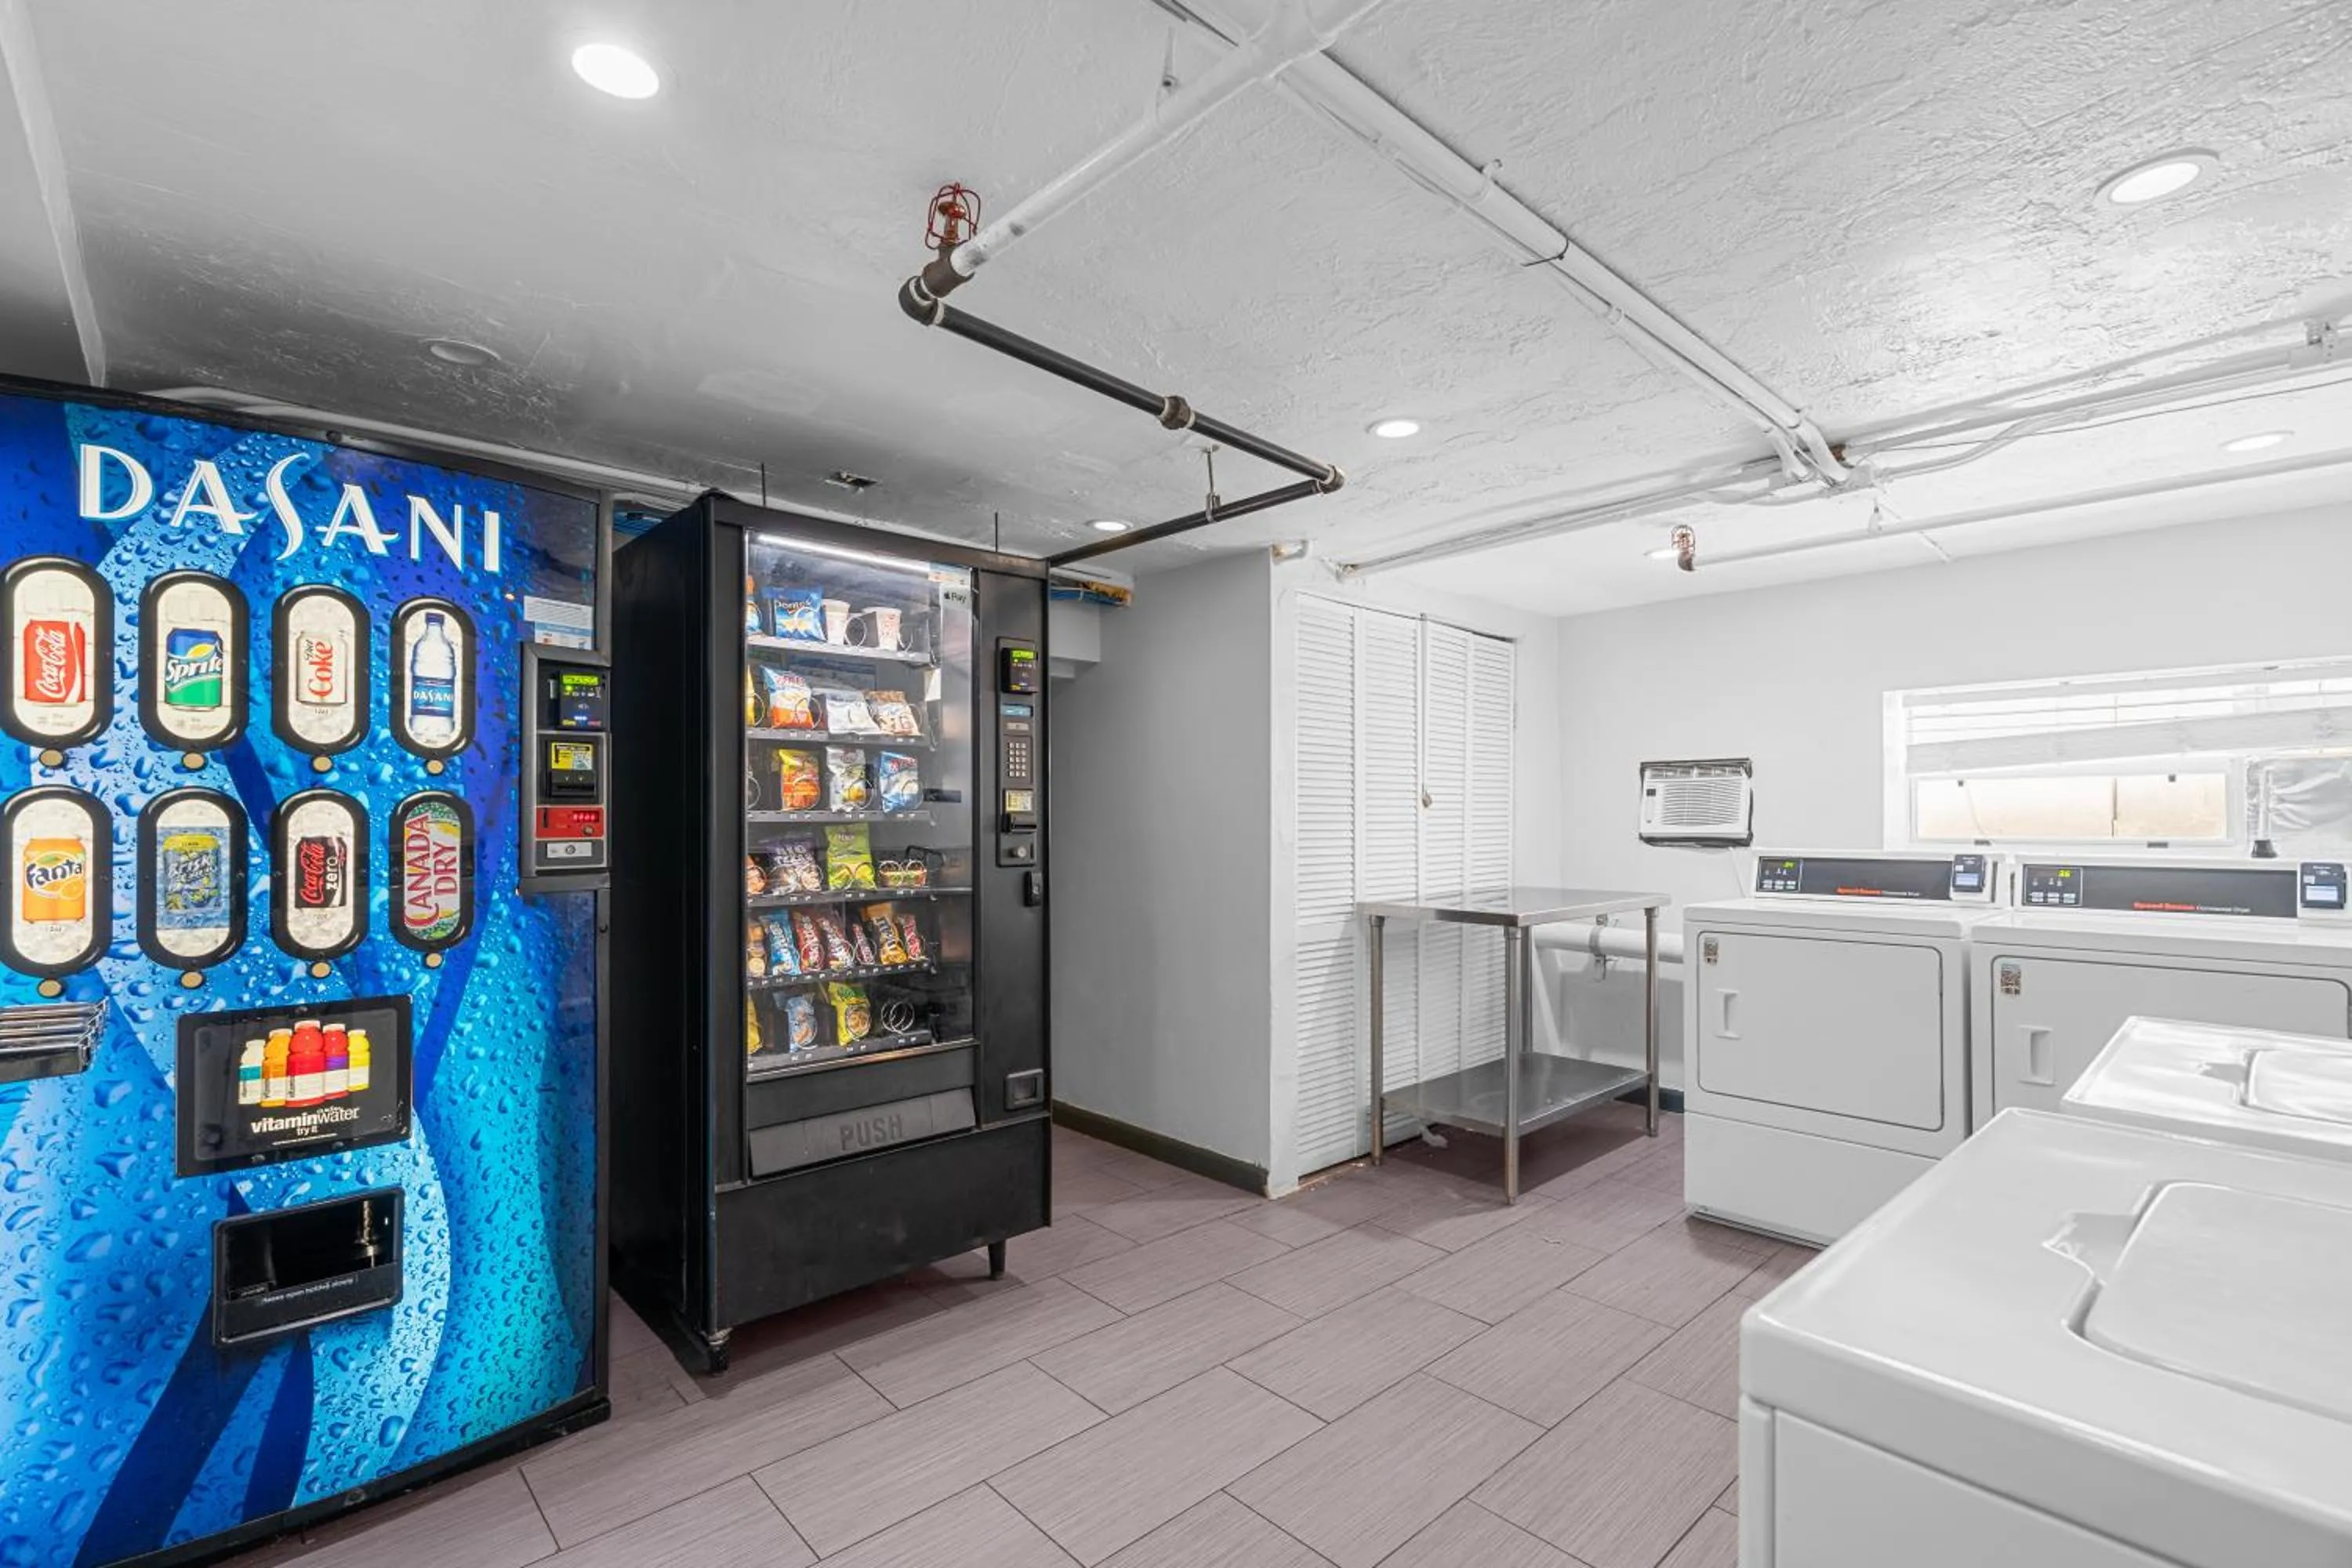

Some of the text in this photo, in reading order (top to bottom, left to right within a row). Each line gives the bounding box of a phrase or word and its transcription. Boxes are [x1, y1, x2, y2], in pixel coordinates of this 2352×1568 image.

[80, 443, 500, 572] DASANI
[165, 654, 223, 684] Sprite
[307, 641, 333, 698] Coke
[413, 689, 454, 703] DASANI
[326, 856, 339, 891] zero
[404, 815, 440, 927] CANADA
[432, 840, 458, 896] DRY
[251, 1106, 361, 1134] vitaminwater
[296, 1127, 310, 1136] try
[840, 1113, 902, 1151] PUSH
